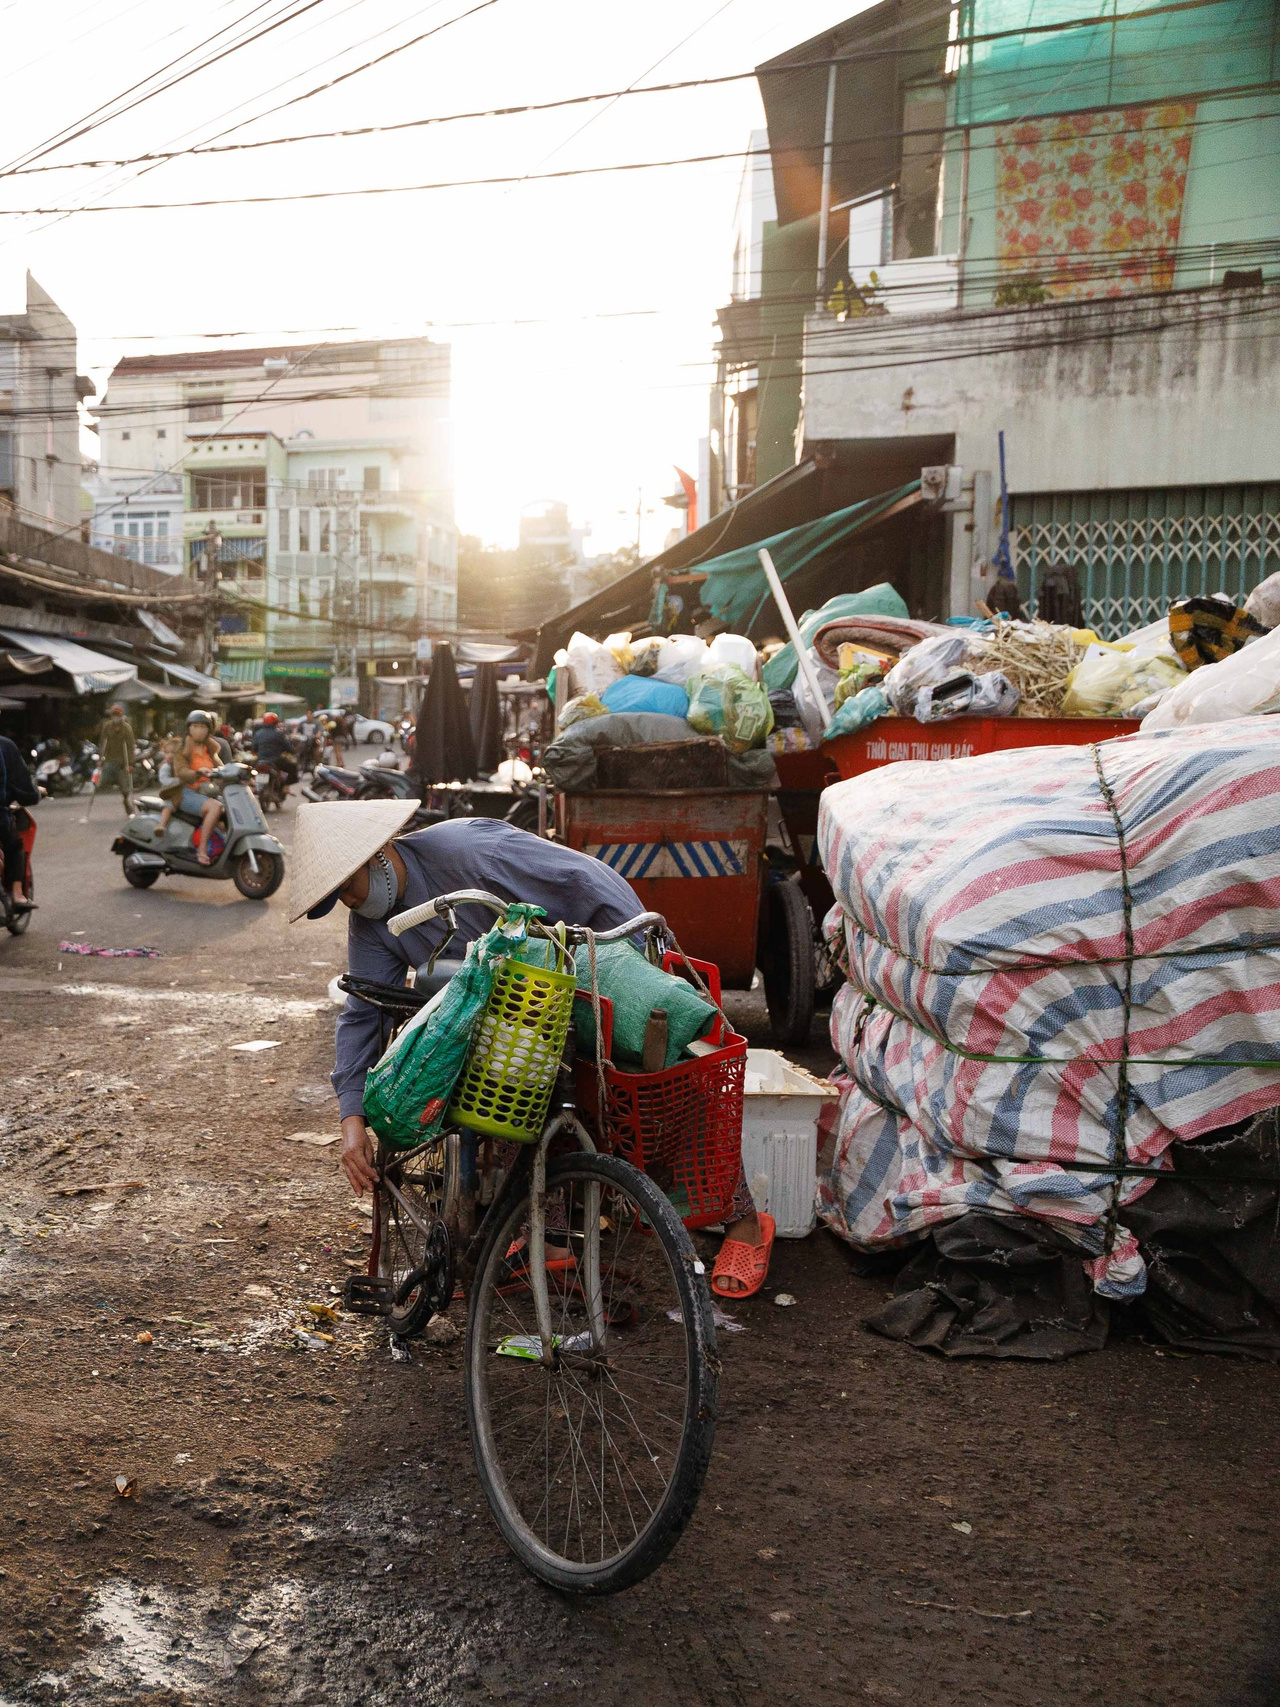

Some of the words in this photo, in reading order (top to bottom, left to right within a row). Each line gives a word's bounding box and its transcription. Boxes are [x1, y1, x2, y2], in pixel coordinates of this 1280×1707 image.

[866, 737, 887, 760] THỜI
[889, 742, 910, 760] GIAN
[911, 742, 929, 760] THU
[931, 743, 952, 760] GOM
[955, 739, 974, 759] RÁC
